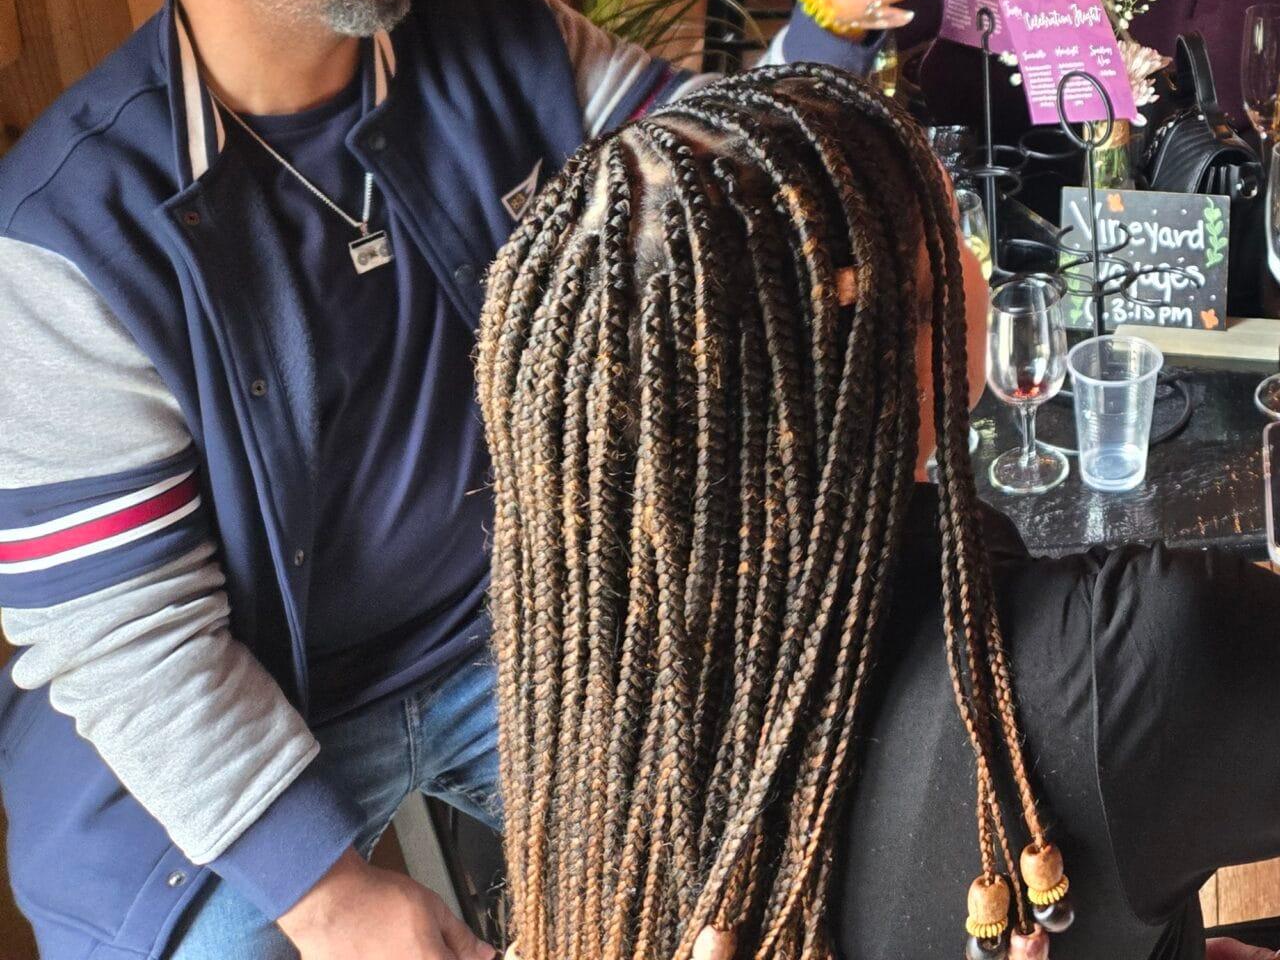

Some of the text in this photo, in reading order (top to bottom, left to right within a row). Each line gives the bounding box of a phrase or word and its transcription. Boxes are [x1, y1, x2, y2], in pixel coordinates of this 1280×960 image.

[1024, 9, 1073, 32] Celebration
[1070, 3, 1102, 28] Flight
[1070, 199, 1206, 254] Vineyard
